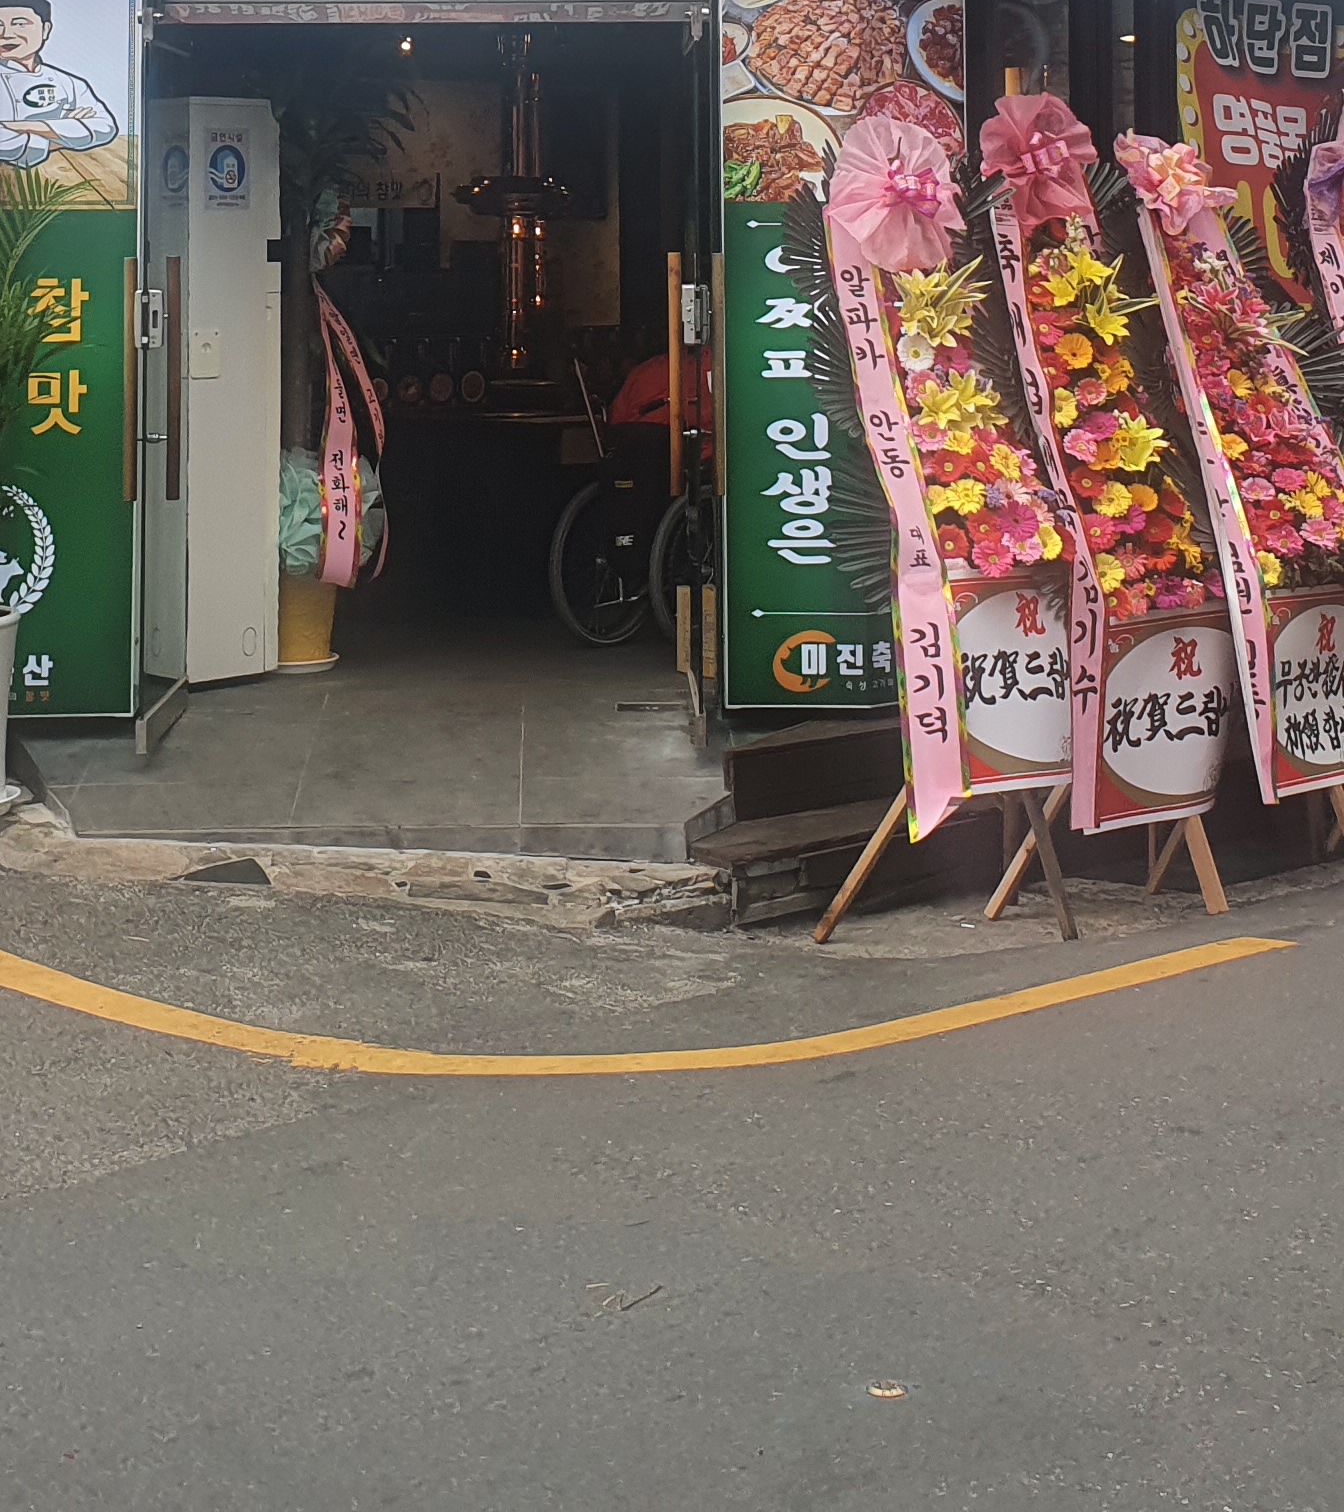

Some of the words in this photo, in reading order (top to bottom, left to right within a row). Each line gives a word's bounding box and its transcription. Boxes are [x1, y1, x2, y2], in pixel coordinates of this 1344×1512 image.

[761, 413, 837, 565] 인생은
[907, 524, 933, 569] 대표
[1014, 592, 1046, 638] 祝
[10, 654, 54, 687] 산
[1168, 636, 1203, 680] 祝
[909, 622, 950, 745] 김기덕
